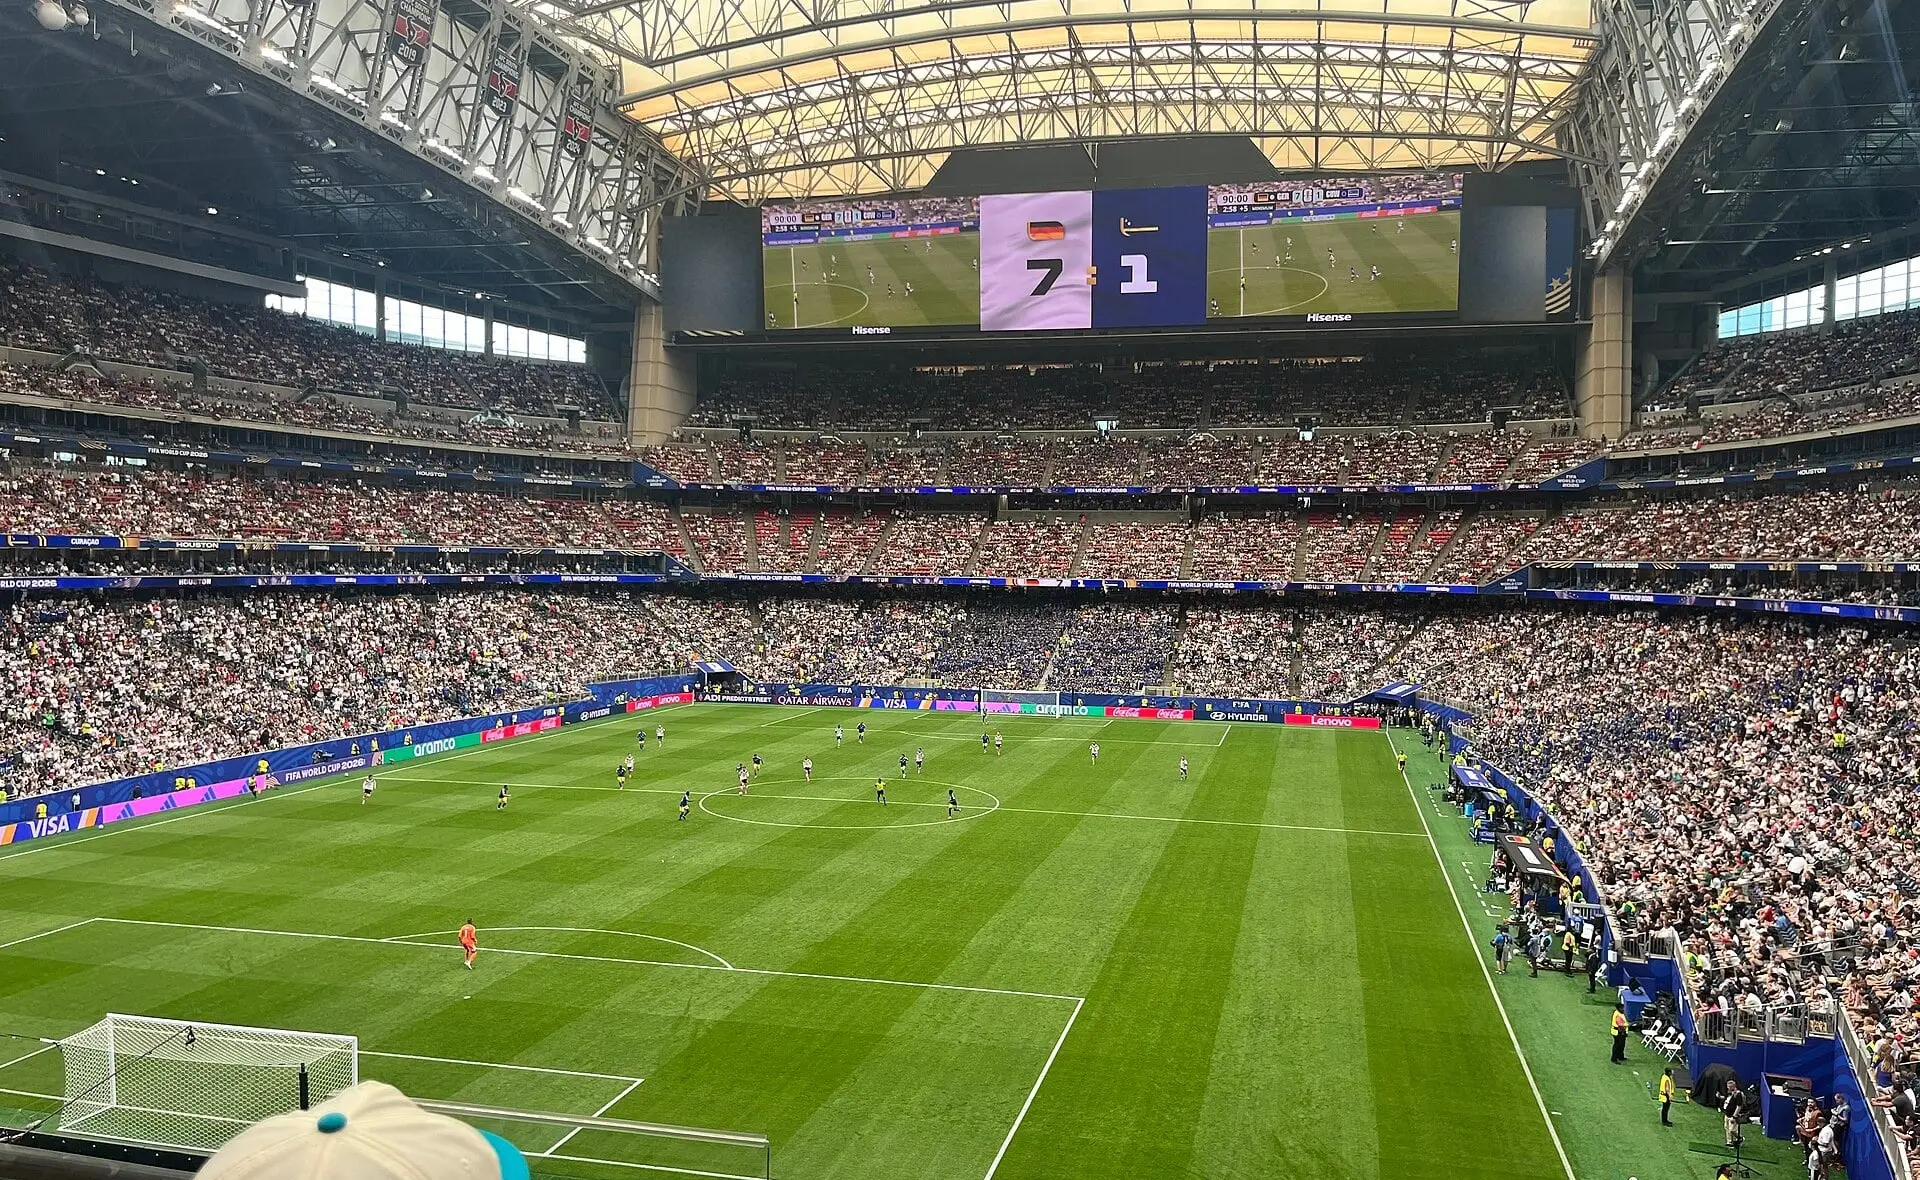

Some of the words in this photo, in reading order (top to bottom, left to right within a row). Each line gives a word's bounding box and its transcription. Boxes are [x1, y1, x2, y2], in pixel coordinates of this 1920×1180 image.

[400, 1, 431, 25] CHAMPIONS
[398, 43, 417, 61] 2019
[494, 59, 519, 79] CHAMPIONS
[492, 96, 507, 113] 2023
[566, 139, 580, 154] 2024
[1222, 195, 1248, 203] 90:00
[1295, 192, 1300, 200] 7
[774, 215, 797, 223] 90:00
[1026, 258, 1063, 296] 7
[1120, 254, 1158, 294] 1
[1307, 313, 1352, 322] Hisense
[852, 326, 891, 335] Hisense
[159, 448, 179, 456] WORLD
[416, 470, 447, 478] HOUSTON
[1797, 467, 1826, 476] HOUSTON
[70, 538, 100, 547] CURAÇAO
[16, 580, 31, 588] CUP
[31, 579, 58, 588] 2026
[1056, 579, 1064, 587] 7
[635, 700, 652, 709] Lenovo
[658, 695, 680, 704] Lenovo
[704, 694, 721, 702] ADI
[778, 696, 809, 706] QATAR
[812, 696, 852, 706] AIRWAYS
[883, 698, 908, 709] VISA
[543, 708, 556, 717] FIFA
[589, 707, 611, 718] HYUNDAI
[1036, 704, 1088, 715] aramco
[1227, 712, 1268, 722] HYUNDAI
[1311, 714, 1352, 726] Lenovo
[413, 737, 456, 757] aramco
[285, 771, 301, 782] FIFA
[301, 766, 327, 779] WORLD
[328, 762, 341, 773] CUP
[26, 814, 70, 838] VISA
